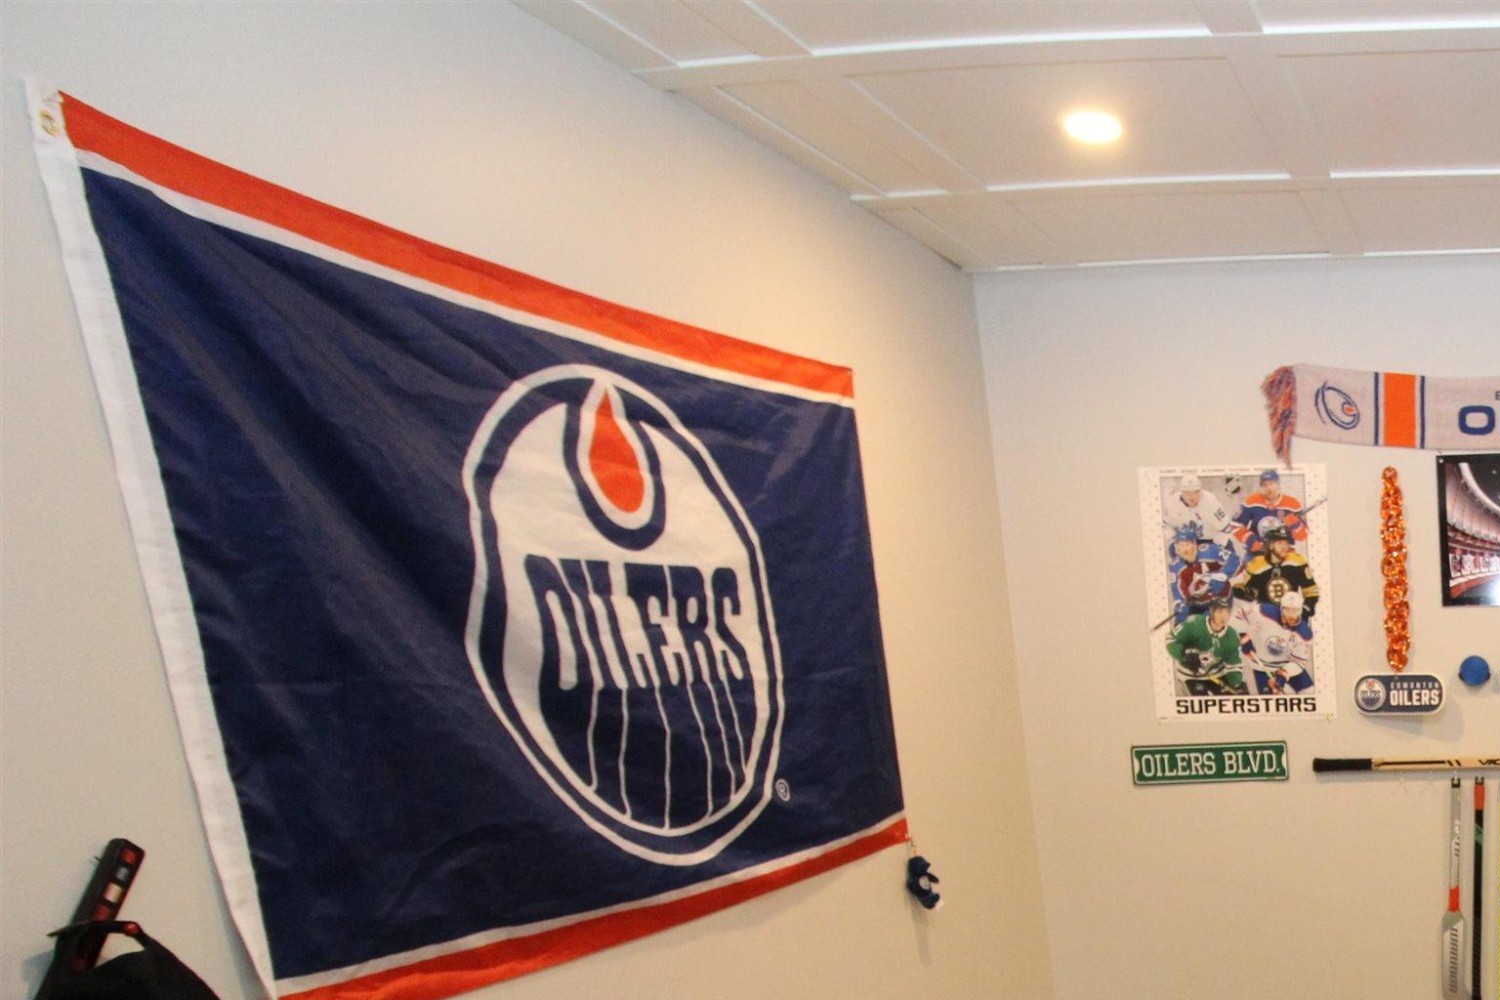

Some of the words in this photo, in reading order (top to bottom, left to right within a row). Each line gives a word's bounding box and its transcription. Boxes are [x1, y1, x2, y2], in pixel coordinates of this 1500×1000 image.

[524, 553, 754, 692] OILERS
[1176, 697, 1317, 714] SUPERSTARS
[1390, 689, 1440, 706] OILERS
[1141, 752, 1217, 778] OILERS
[1223, 749, 1281, 774] BLVD.
[1449, 928, 1458, 994] WARRIOR
